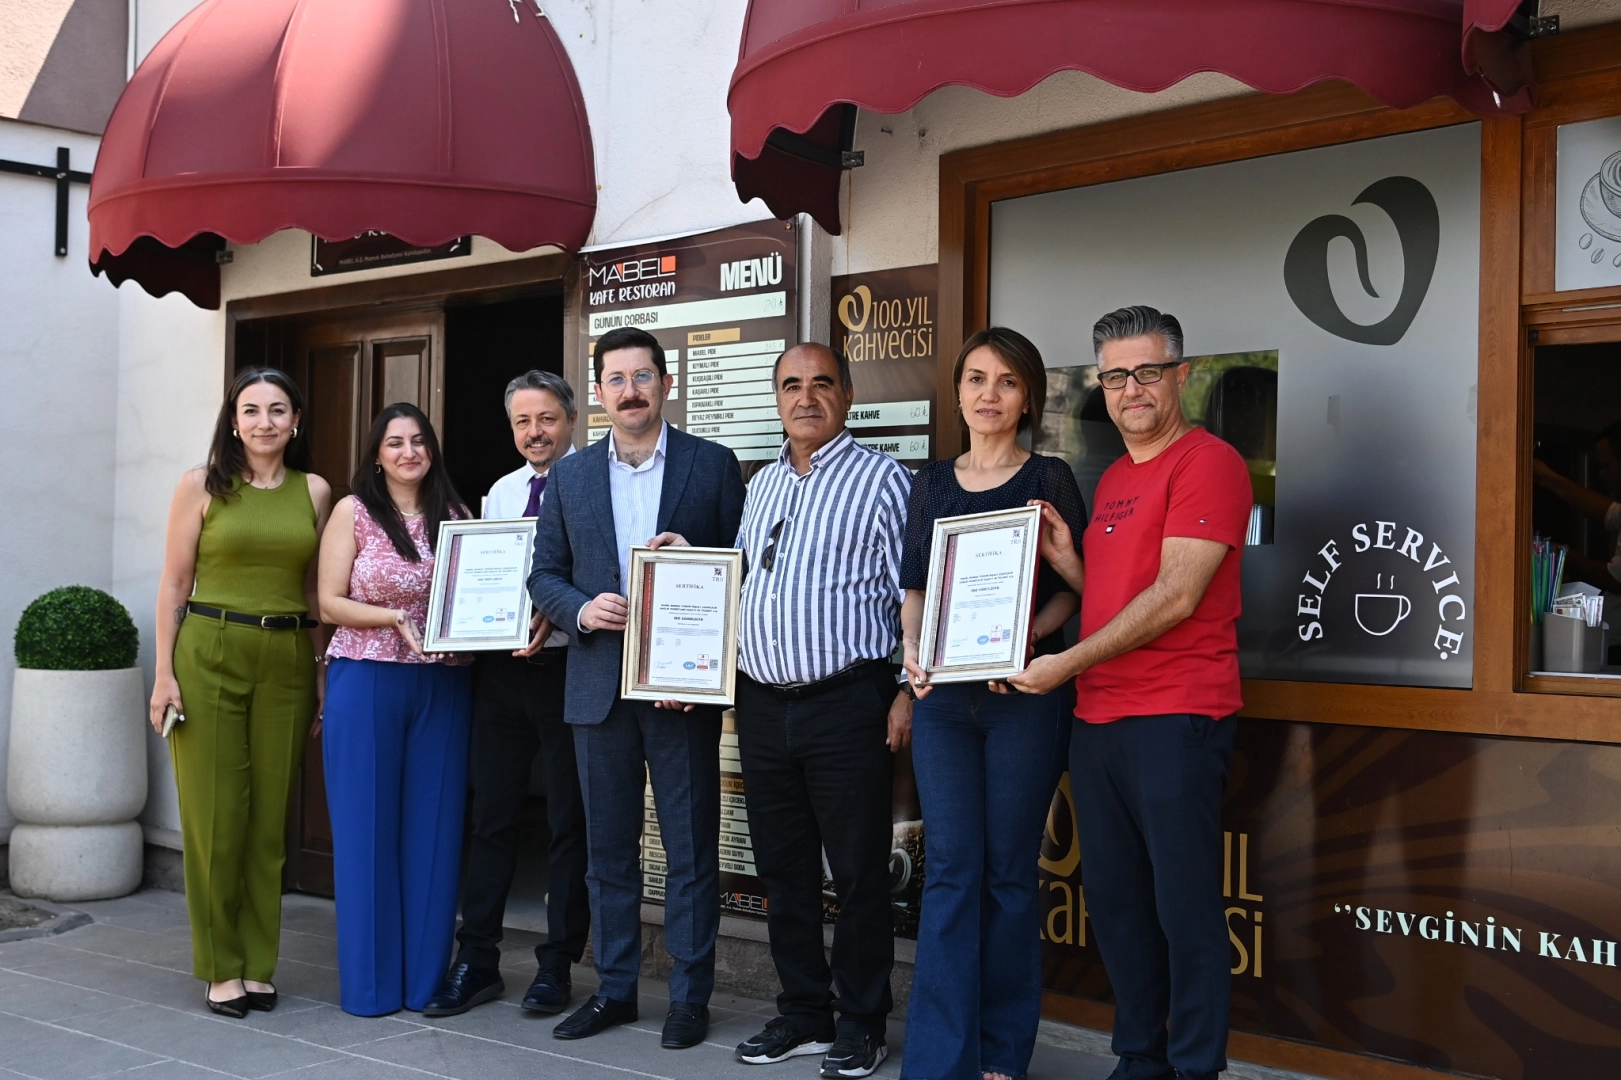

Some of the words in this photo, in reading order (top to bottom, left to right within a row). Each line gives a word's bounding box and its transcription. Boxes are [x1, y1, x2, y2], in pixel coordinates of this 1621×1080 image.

[589, 256, 676, 287] MABEL
[720, 252, 782, 292] MENÜ
[590, 289, 616, 305] KAFE
[619, 281, 676, 301] RESTORAN
[594, 315, 622, 329] GÜNÜN
[624, 312, 658, 327] ÇORBASI
[860, 410, 880, 420] KAHVE
[880, 443, 900, 452] KAHVE
[910, 441, 919, 452] 60
[1104, 496, 1139, 510] TOMMY
[1094, 507, 1134, 522] HILFIGER
[1297, 539, 1342, 642] SELF
